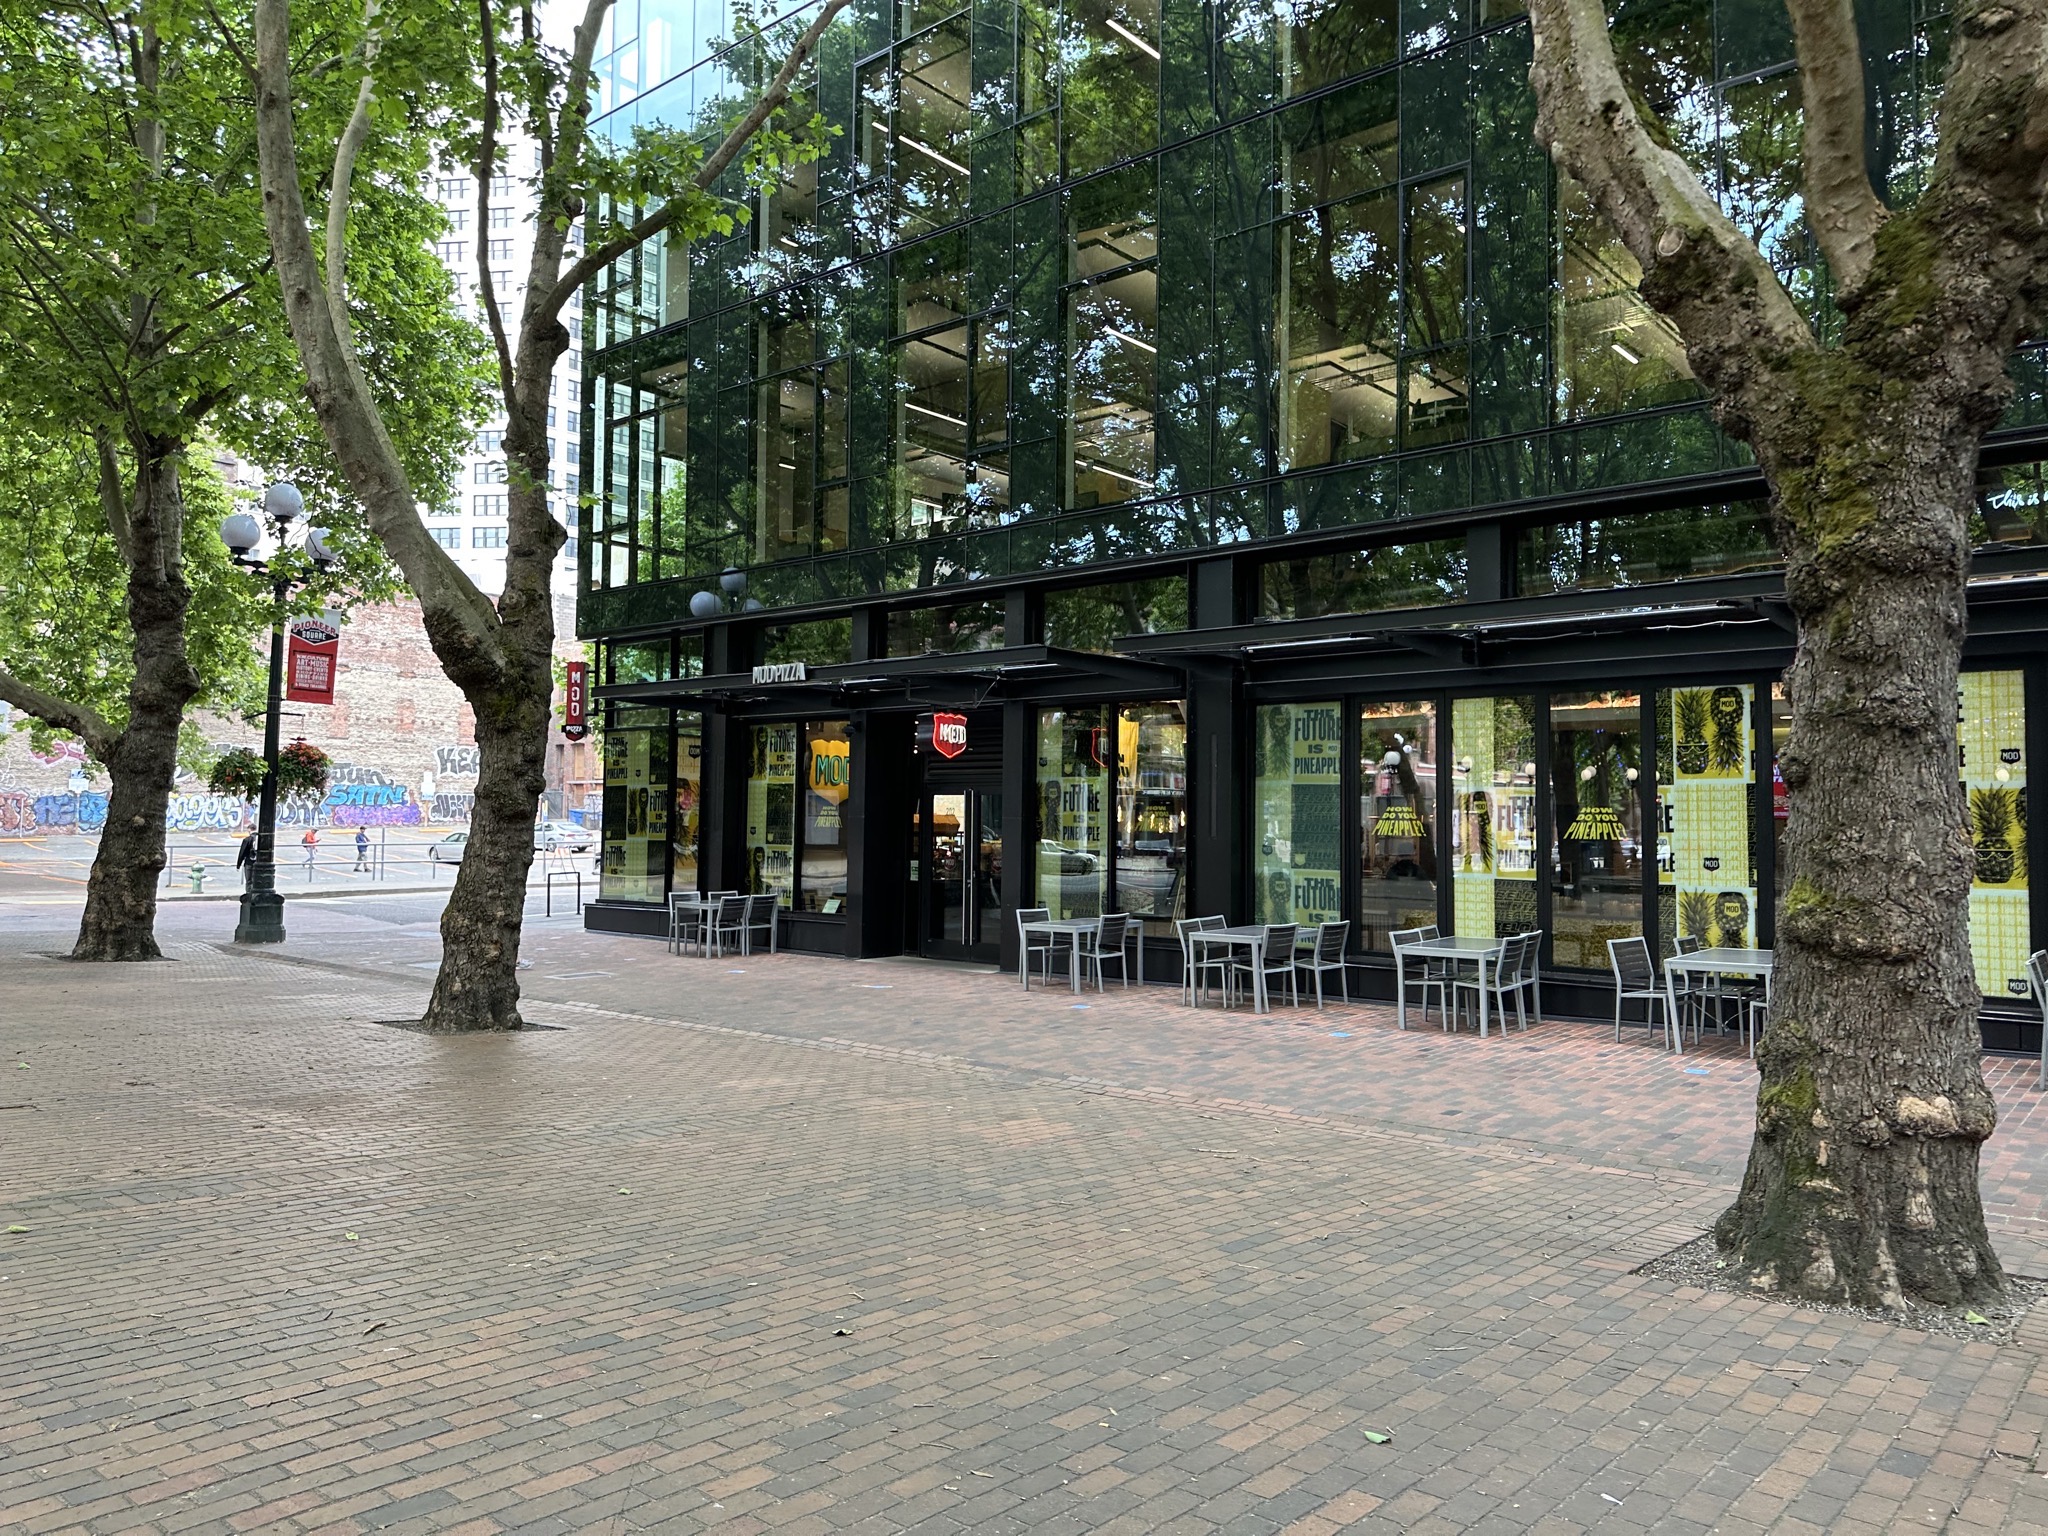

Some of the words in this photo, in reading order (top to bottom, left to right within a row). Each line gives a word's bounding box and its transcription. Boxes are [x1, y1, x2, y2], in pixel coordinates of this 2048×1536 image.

[1986, 489, 2025, 510] This
[293, 620, 337, 637] PIONEER
[302, 630, 327, 640] SQUARE
[752, 665, 774, 685] MOD
[774, 662, 806, 682] PIZZA
[571, 671, 581, 717] MOD
[1304, 708, 1335, 719] THE
[565, 725, 583, 733] PIZZA
[939, 723, 967, 745] MOD
[1308, 744, 1324, 754] IS
[2002, 751, 2019, 760] MOD
[1294, 757, 1340, 775] PINEAPPL
[1063, 791, 1100, 812] FUTURE
[1371, 819, 1427, 837] PINEAPPLE?
[1563, 821, 1628, 840] PINEAPPLE?
[1304, 877, 1335, 887] THE
[1309, 913, 1324, 923] IS
[2009, 981, 2027, 991] MOD
